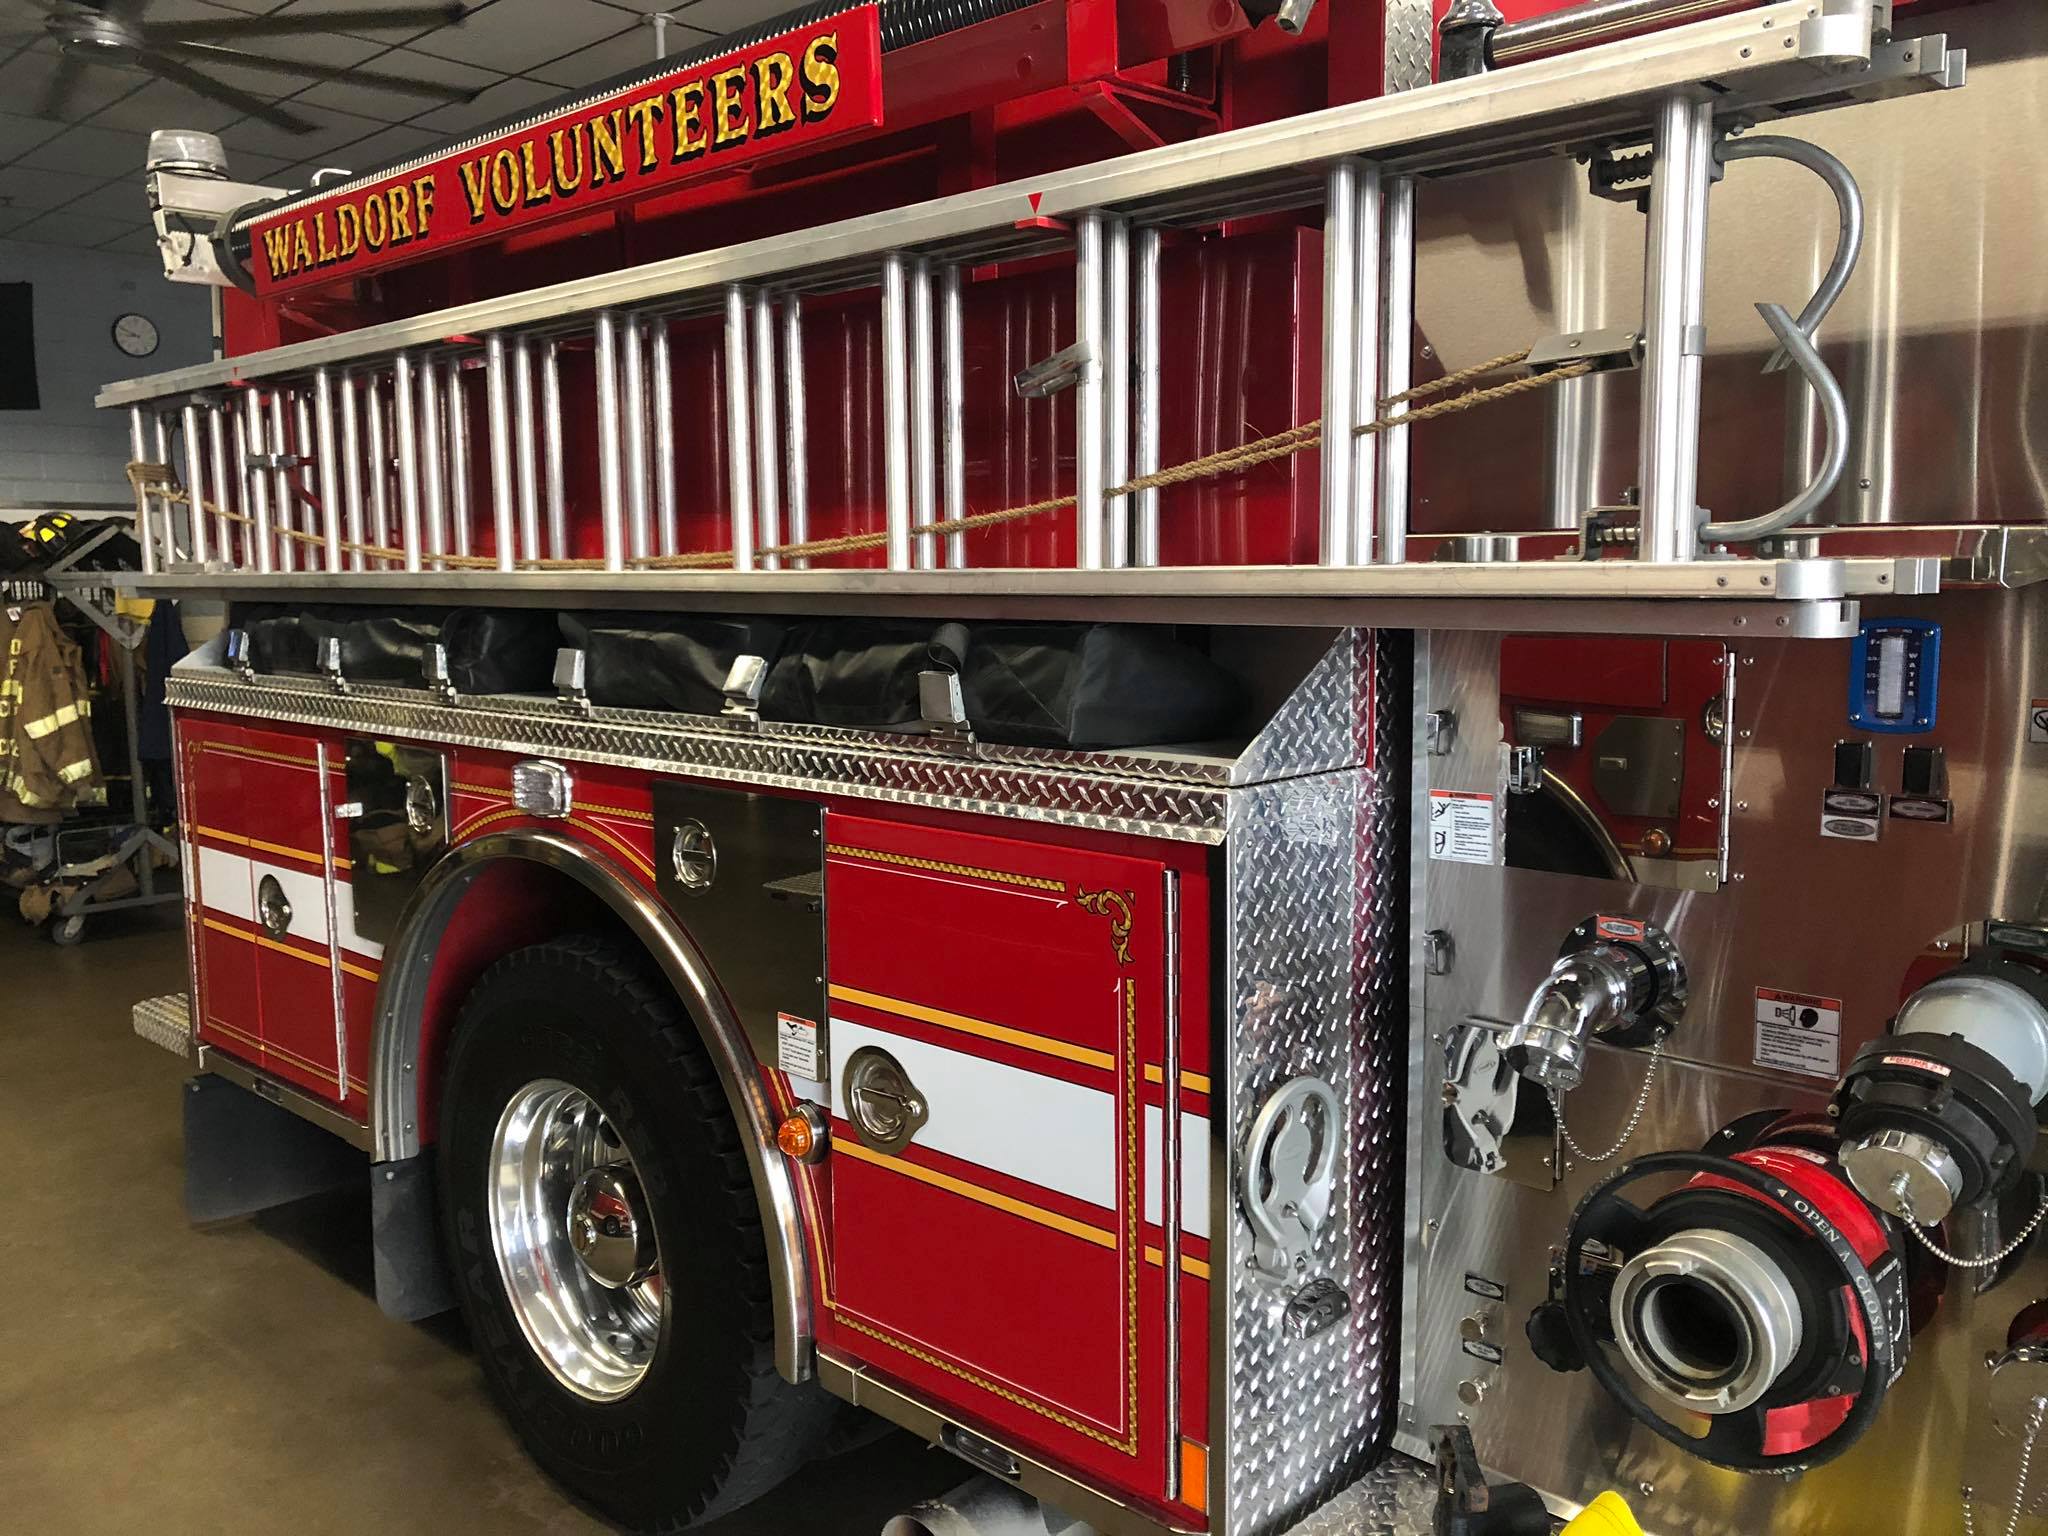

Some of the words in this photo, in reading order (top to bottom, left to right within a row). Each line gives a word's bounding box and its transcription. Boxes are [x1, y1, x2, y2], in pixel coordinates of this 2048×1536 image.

[263, 174, 436, 282] WALDORF
[458, 31, 841, 224] VOLUNTEERS
[1908, 652, 1918, 697] WATER
[1794, 1200, 1839, 1242] OPEN
[1855, 1275, 1884, 1335] CLOSE
